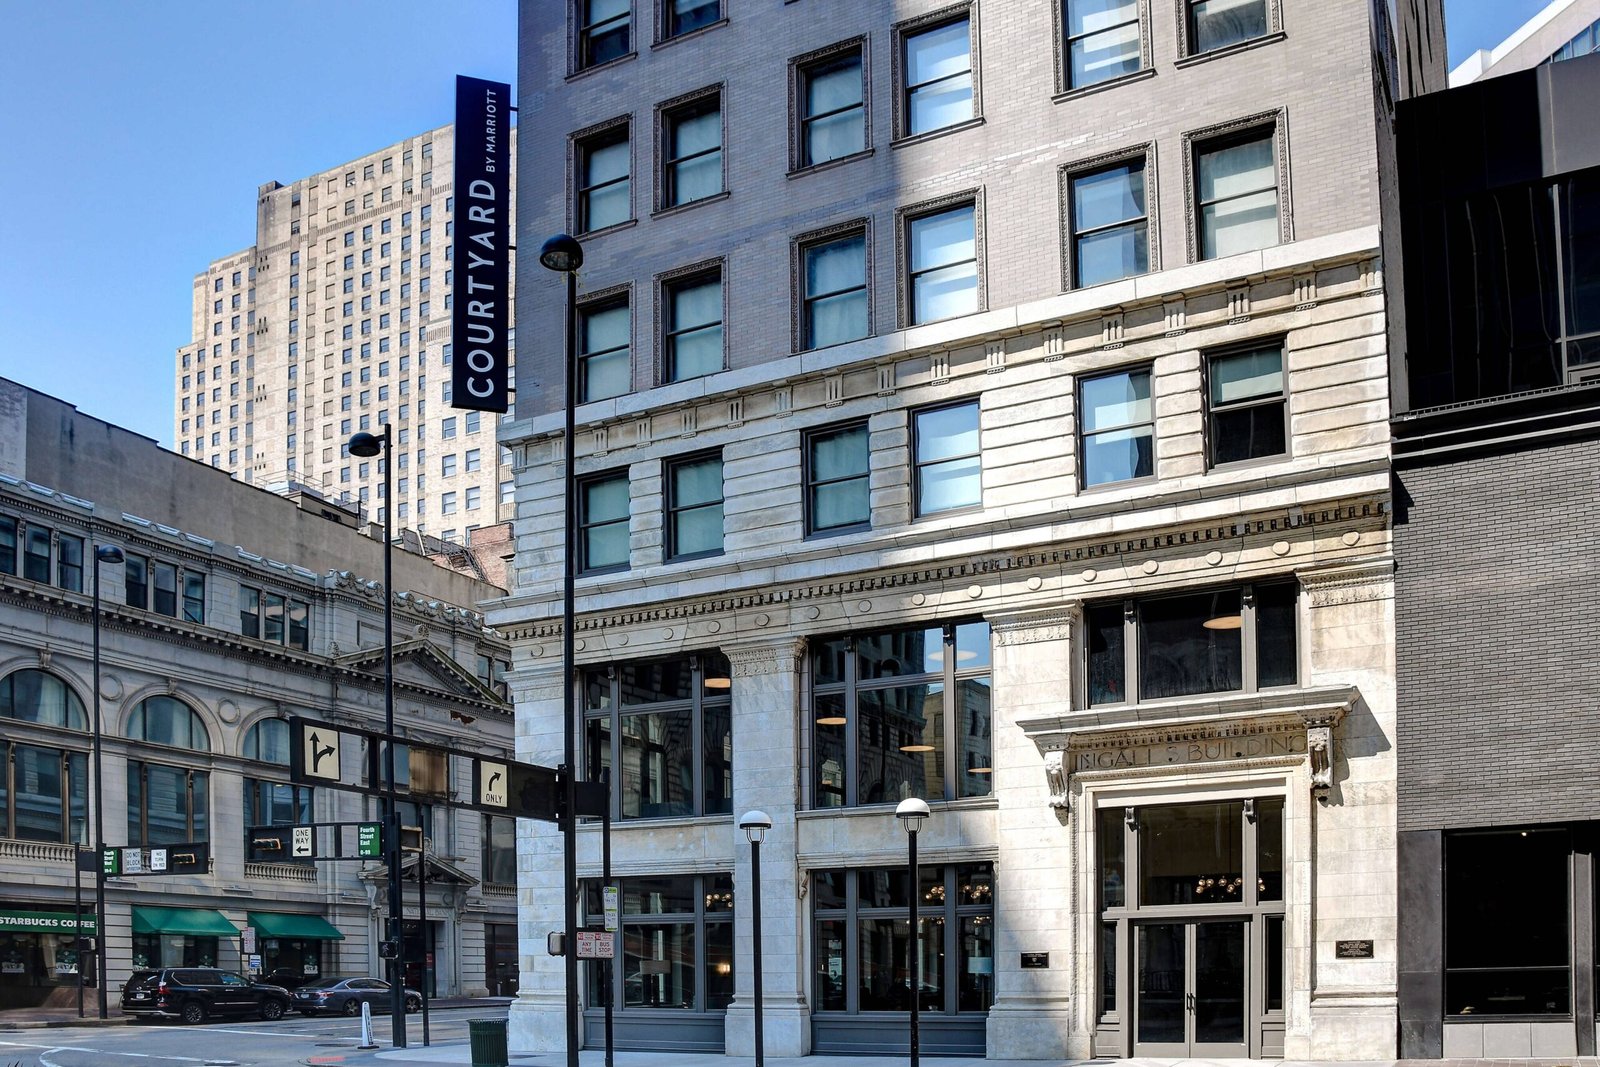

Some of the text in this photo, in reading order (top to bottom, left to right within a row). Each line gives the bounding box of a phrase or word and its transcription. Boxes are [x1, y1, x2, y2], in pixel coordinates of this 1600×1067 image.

[486, 88, 497, 173] BY MARRIOTT
[466, 179, 495, 398] COURTYARD
[1187, 735, 1307, 761] BUILDING
[485, 793, 503, 804] ONLY
[295, 829, 309, 837] ONE
[295, 837, 309, 845] WAY
[0, 916, 59, 927] STARBUCKS
